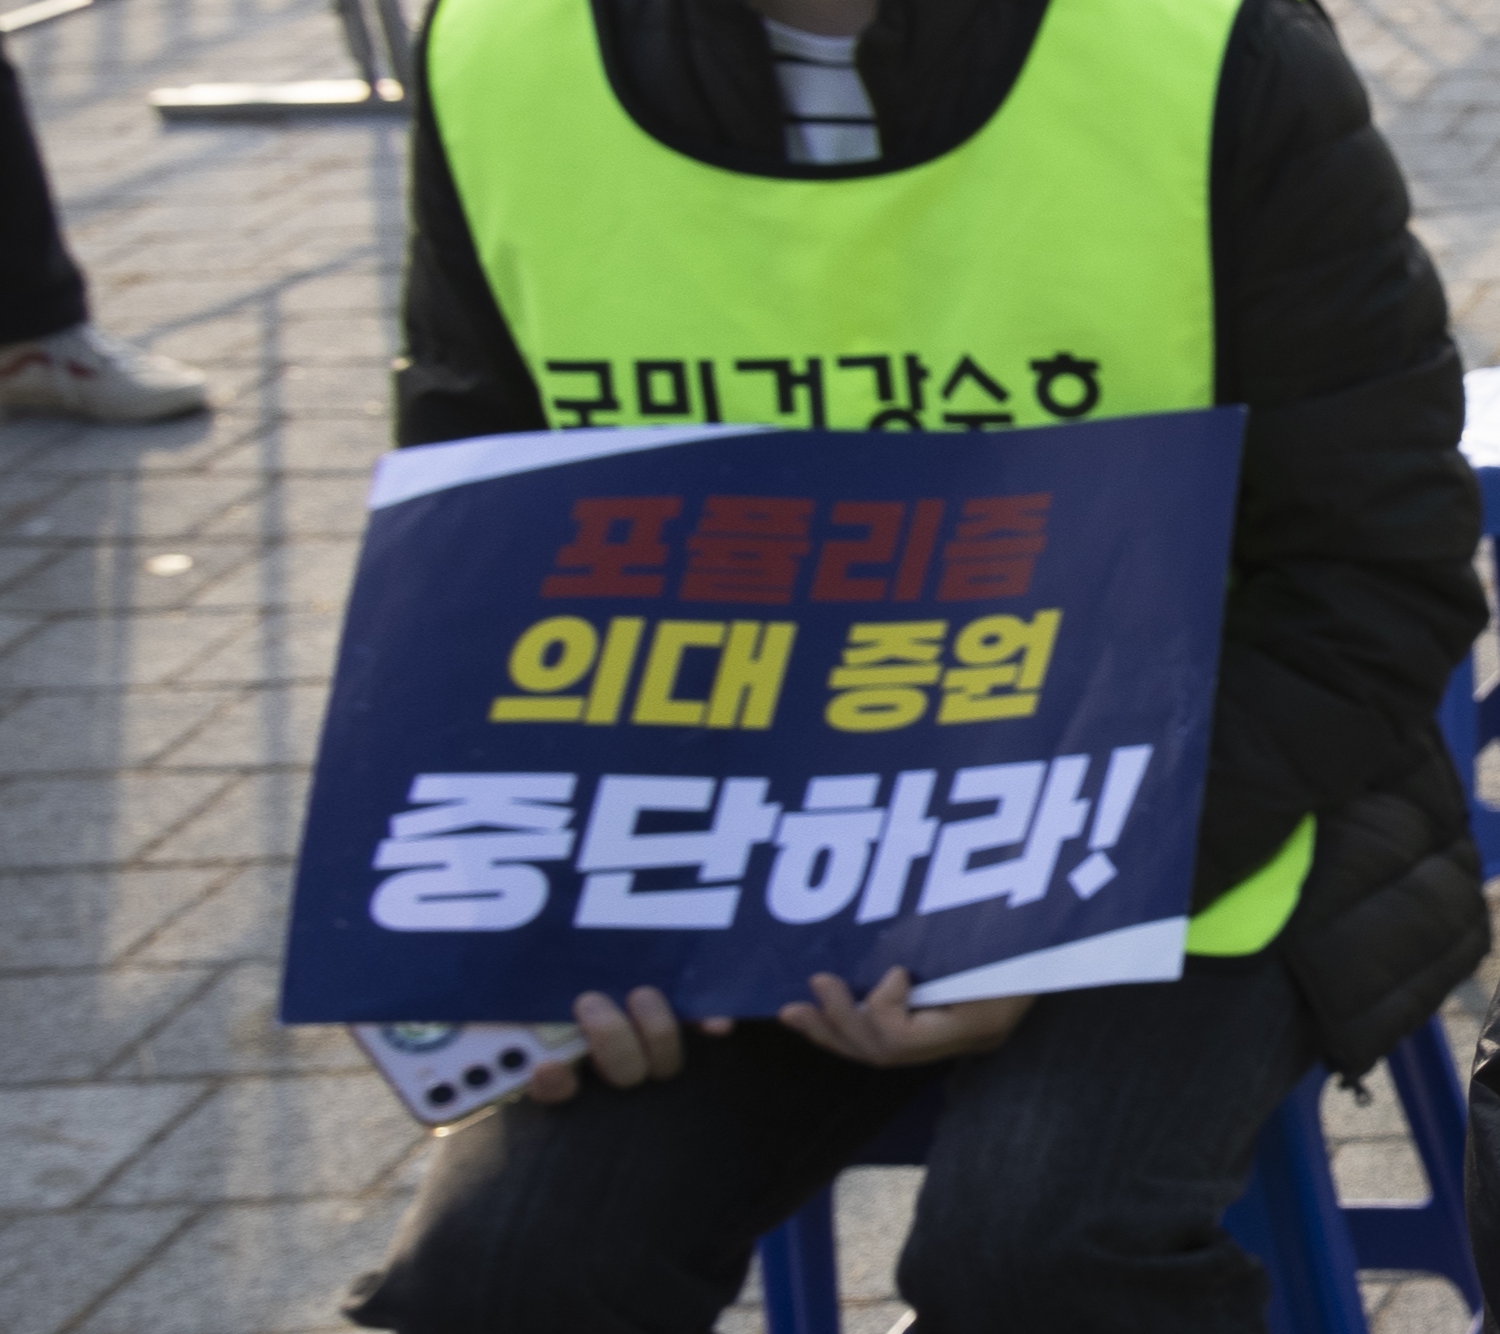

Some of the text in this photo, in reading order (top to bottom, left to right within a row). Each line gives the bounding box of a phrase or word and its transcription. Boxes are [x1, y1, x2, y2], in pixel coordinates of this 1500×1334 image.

[540, 495, 1052, 605] 포퓰리즘
[489, 611, 1062, 732] 의대 증원
[369, 744, 1153, 933] 중단하라!
